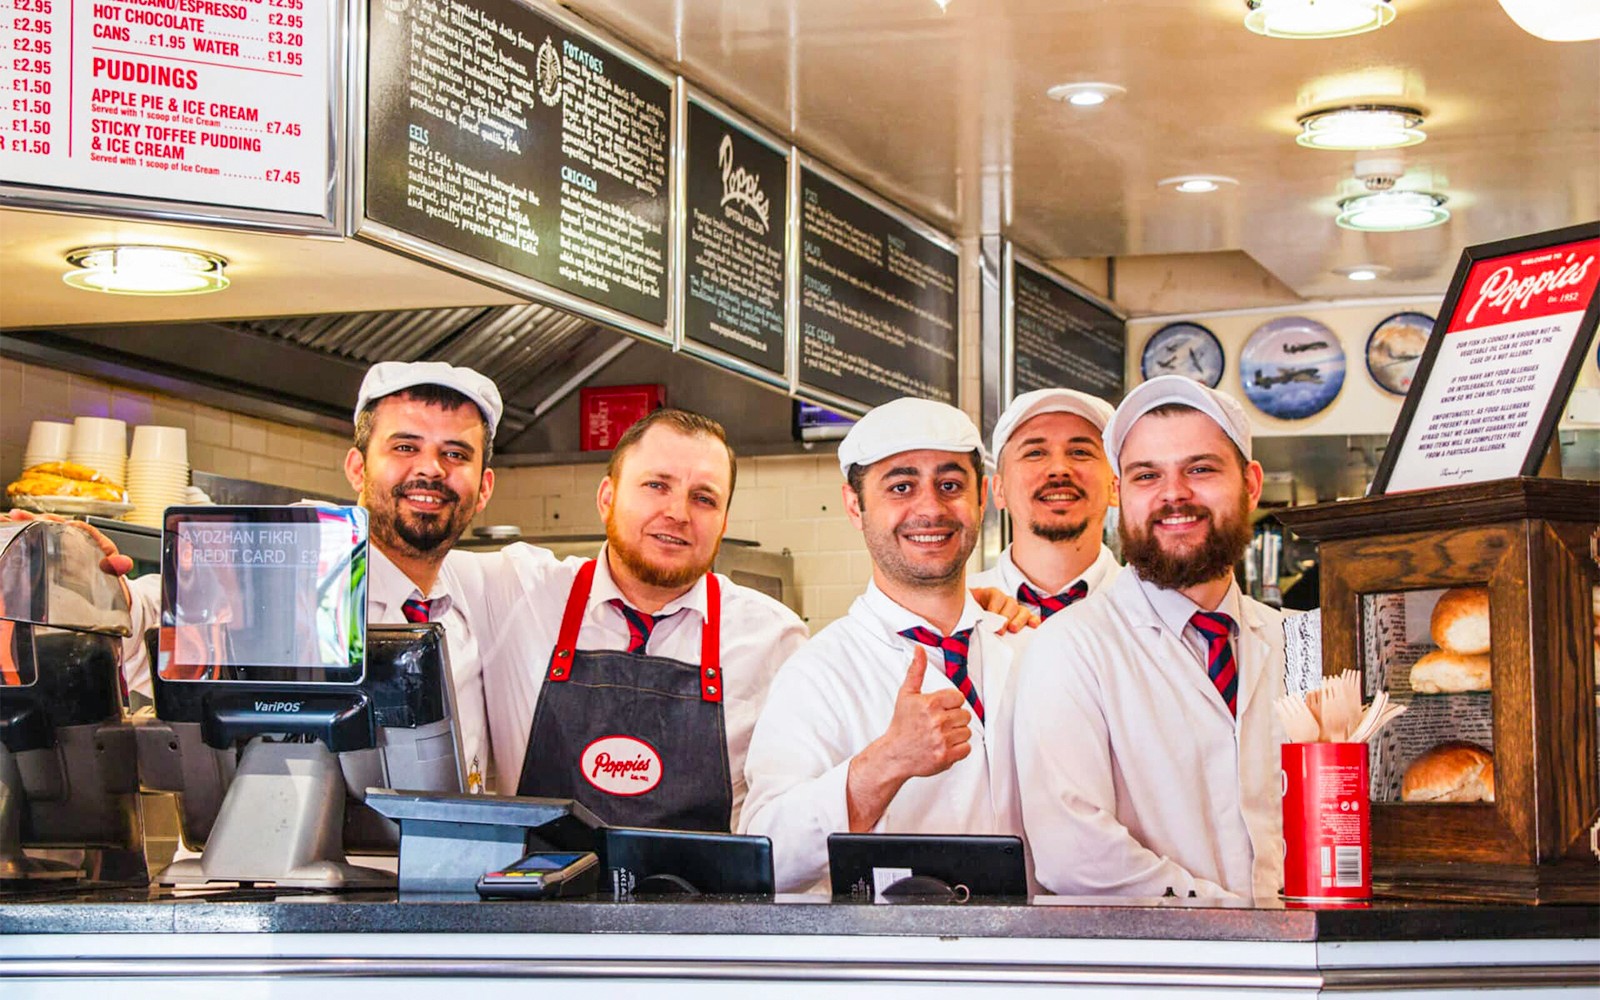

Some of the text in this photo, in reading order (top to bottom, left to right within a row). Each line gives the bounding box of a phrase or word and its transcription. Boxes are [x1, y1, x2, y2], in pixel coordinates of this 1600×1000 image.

[14, 0, 52, 14] £2.95
[14, 18, 52, 34] £2.95
[93, 4, 302, 46] HOT CHOCOLATE £3.20
[268, 12, 302, 28] £2.95
[14, 38, 52, 54] £2.95
[93, 23, 302, 65] CANS £1.95 WATER £1.95
[563, 40, 603, 74] POTATOES
[13, 59, 51, 75] £2.95
[93, 57, 196, 89] PUDDINGS
[13, 79, 51, 95] £1.50
[13, 99, 51, 115] £1.50
[91, 88, 258, 120] APPLE PIE & ICE CREAM
[13, 119, 50, 135] £1.50
[91, 103, 301, 136] Served with 1 scoop of Ice Cream £7.45
[91, 119, 260, 151] STICKY TOFFEE PUDDING
[409, 124, 428, 144] EELS
[12, 139, 50, 155] £1.50
[91, 135, 184, 159] & ICE CREAM
[90, 152, 300, 184] Served with 1 scoop of Ice Cream £7.45
[409, 141, 432, 159] Nick's
[528, 190, 539, 205] the
[408, 154, 425, 170] East
[428, 162, 444, 179] End
[446, 170, 461, 185] and
[507, 193, 519, 209] for
[561, 165, 597, 192] CHICKEN
[407, 194, 423, 210] and
[462, 192, 477, 205] and
[1465, 253, 1595, 323] Poppies
[1460, 347, 1487, 356] VEGETABLE
[1495, 368, 1509, 376] FOOD
[1496, 377, 1515, 385] PLEASE
[1439, 420, 1462, 428] PRESENT
[1463, 427, 1484, 435] CANNOT
[1485, 422, 1515, 432] GUARANTEE
[1472, 433, 1506, 443] COMPLETELY
[1446, 446, 1477, 455] PARTICULAR
[259, 530, 298, 544] FIKRI
[242, 549, 286, 563] CARD
[254, 701, 300, 712] VariPOS
[592, 752, 651, 778] Poppies
